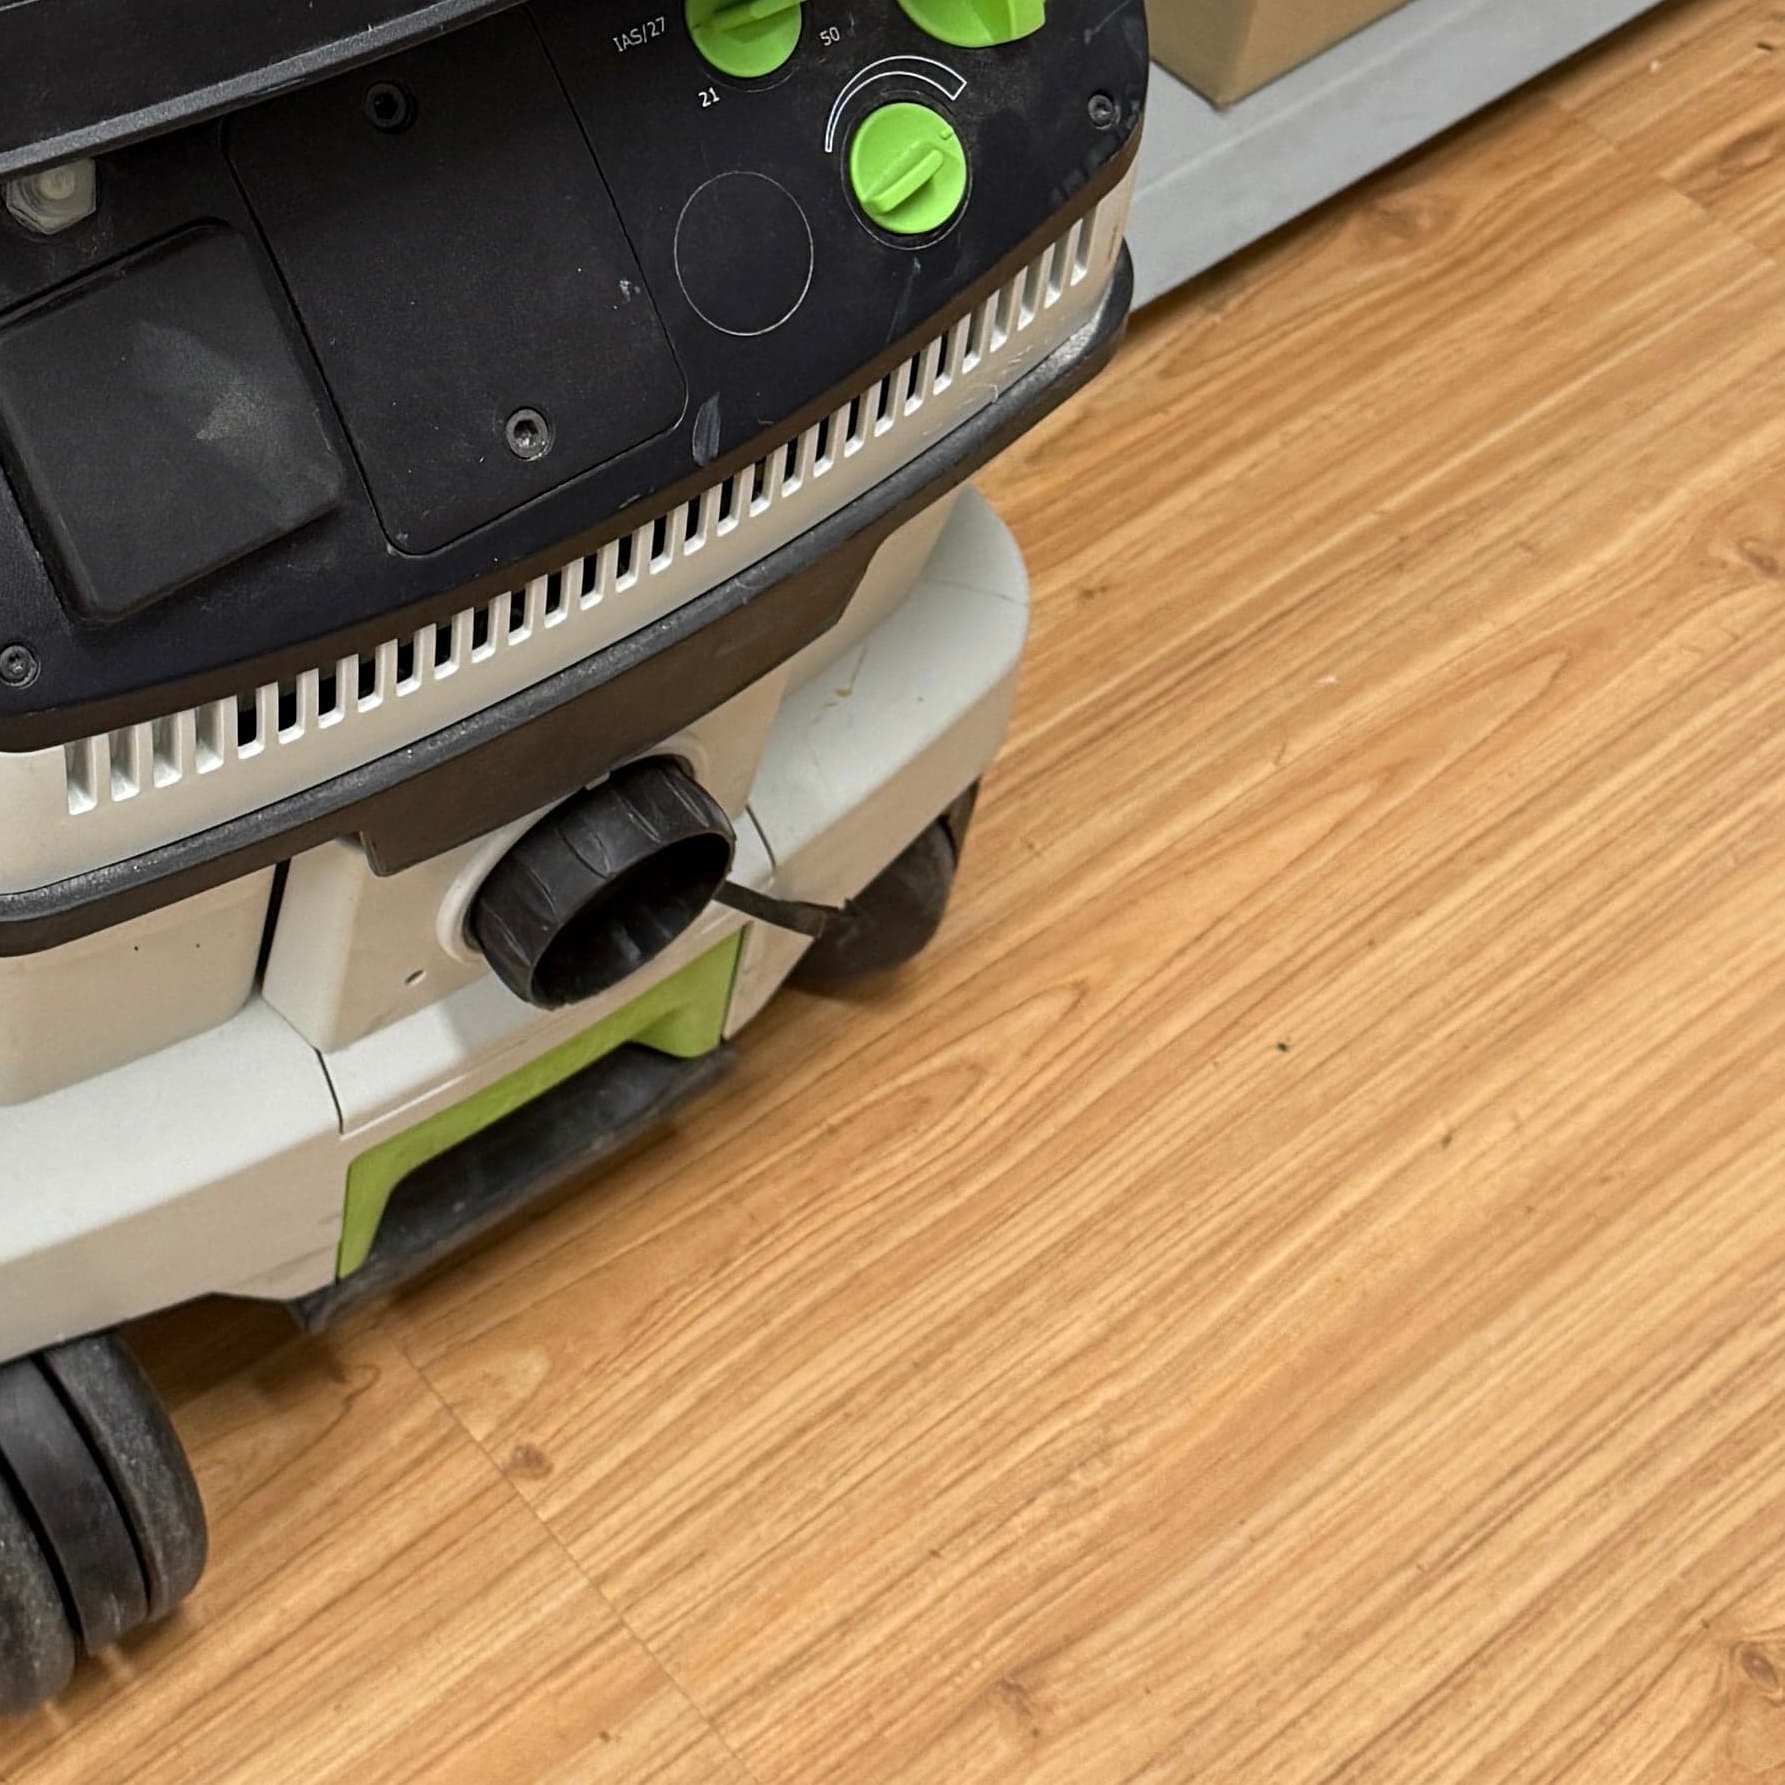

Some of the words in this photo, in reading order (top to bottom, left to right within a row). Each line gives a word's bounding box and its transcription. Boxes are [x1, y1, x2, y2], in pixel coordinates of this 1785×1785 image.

[612, 16, 666, 53] IAS/27
[819, 26, 841, 47] 50
[698, 86, 720, 109] 21
